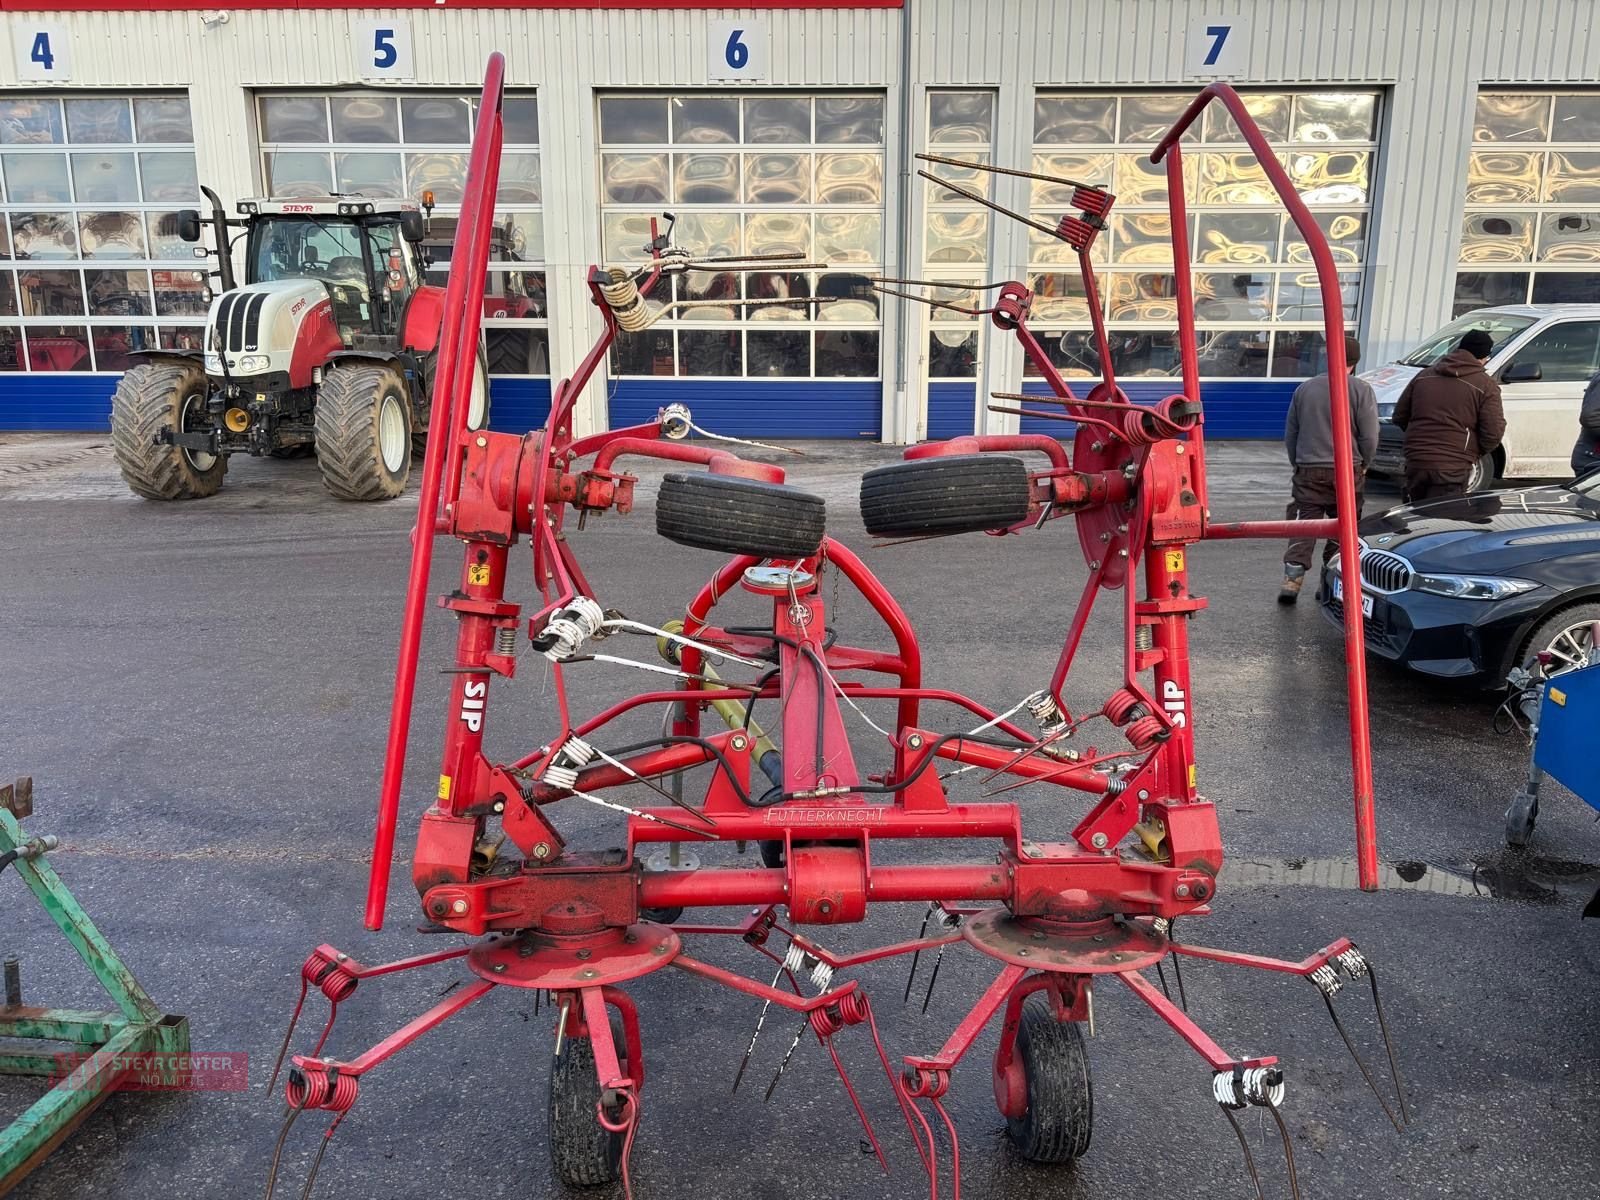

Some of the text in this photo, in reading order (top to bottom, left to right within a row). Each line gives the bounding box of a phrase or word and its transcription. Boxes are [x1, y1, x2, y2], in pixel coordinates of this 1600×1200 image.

[31, 32, 54, 70] 4
[373, 29, 398, 69] 5
[725, 29, 749, 69] 6
[1203, 26, 1231, 65] 7
[282, 204, 314, 212] STEYR
[291, 297, 307, 316] STEYR
[461, 681, 486, 732] SIP
[766, 807, 886, 822] FUTTERKNECHT
